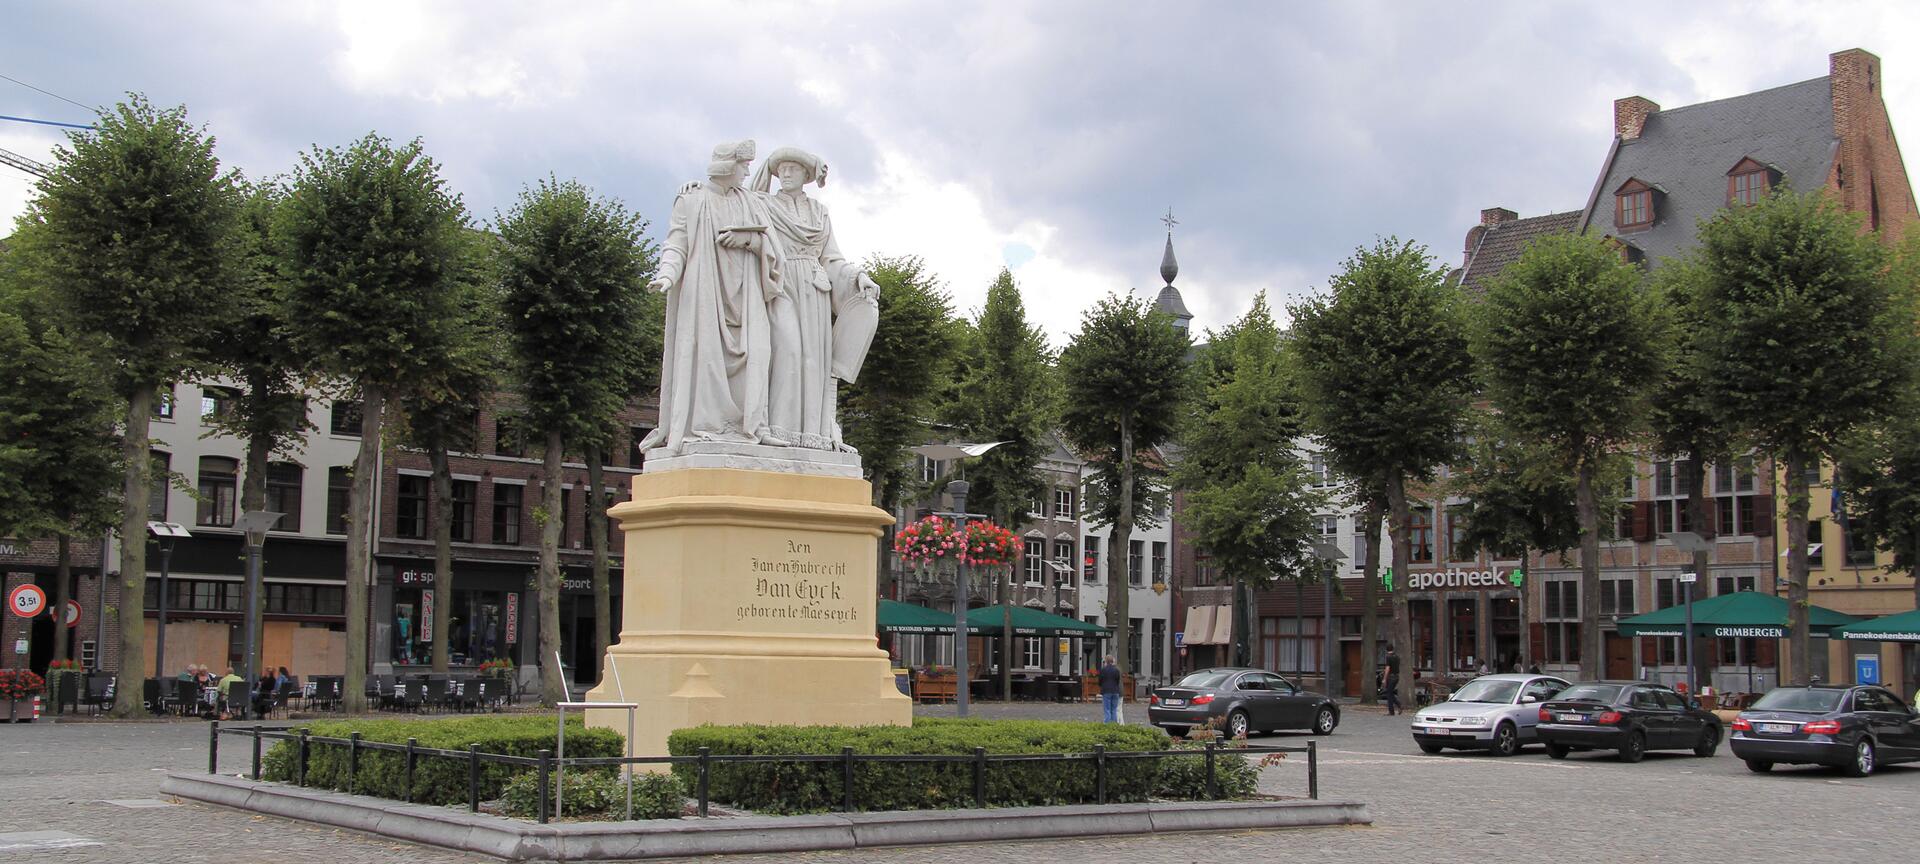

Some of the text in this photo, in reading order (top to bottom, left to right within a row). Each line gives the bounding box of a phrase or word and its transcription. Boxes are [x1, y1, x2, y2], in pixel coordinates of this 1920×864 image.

[787, 540, 811, 554] Aen
[775, 562, 790, 574] en
[790, 560, 846, 578] Hubrecht
[563, 579, 592, 590] sport
[1408, 566, 1506, 590] apotheek
[756, 578, 791, 597] Van
[18, 596, 37, 607] 3,5t
[422, 591, 433, 641] SALE
[737, 603, 786, 621] geboren
[800, 605, 858, 624] Maeseyck
[1715, 627, 1783, 637] GRIMBERGEN
[1863, 667, 1872, 678] U
